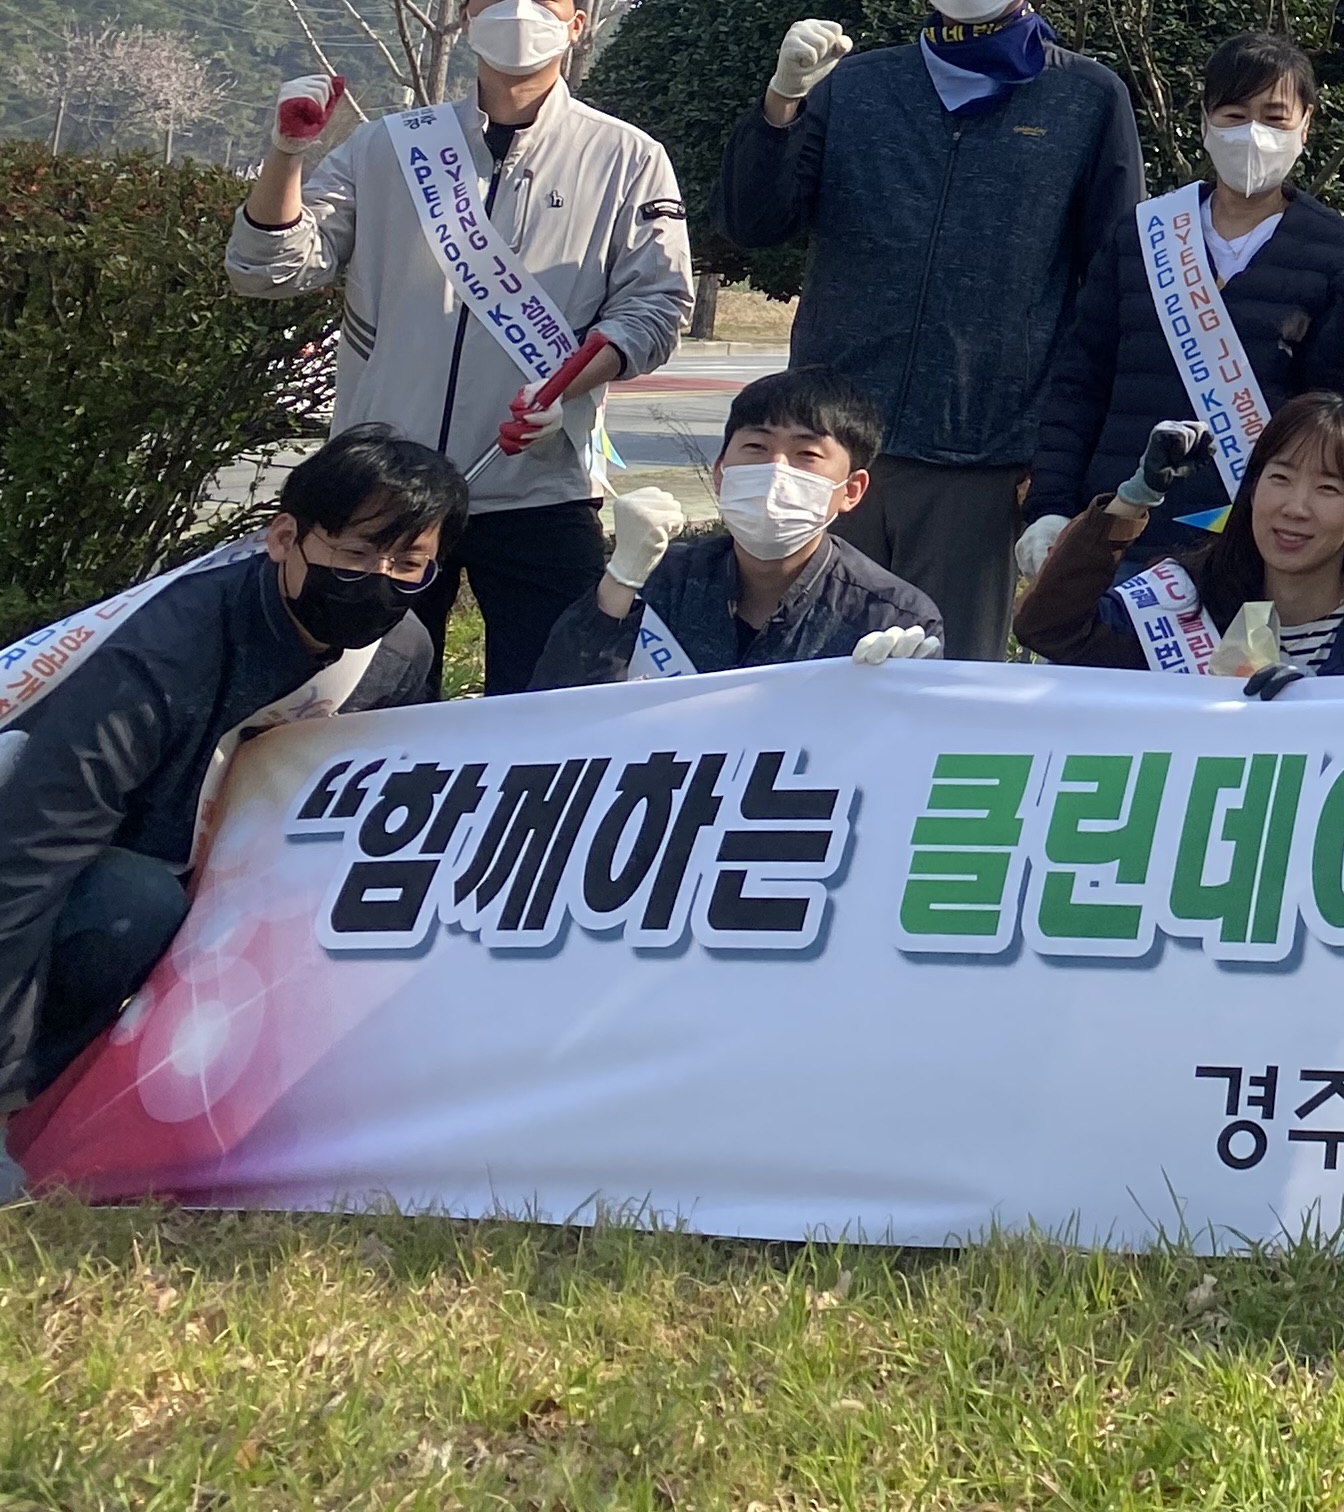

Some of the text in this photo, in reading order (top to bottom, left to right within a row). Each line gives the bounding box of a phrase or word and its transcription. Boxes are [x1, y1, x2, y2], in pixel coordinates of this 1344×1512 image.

[410, 146, 444, 219] APEC
[435, 223, 489, 301] 2025
[486, 303, 552, 379] KORE
[439, 147, 576, 366] GYEONG JU 성공개
[1147, 215, 1246, 481] APEC 2025 KORE
[1172, 212, 1265, 445] GYEONG JU 성공
[640, 627, 682, 677] AP
[1144, 616, 1190, 675] 네번
[1152, 564, 1186, 601] EC
[296, 751, 840, 934] “함께하는
